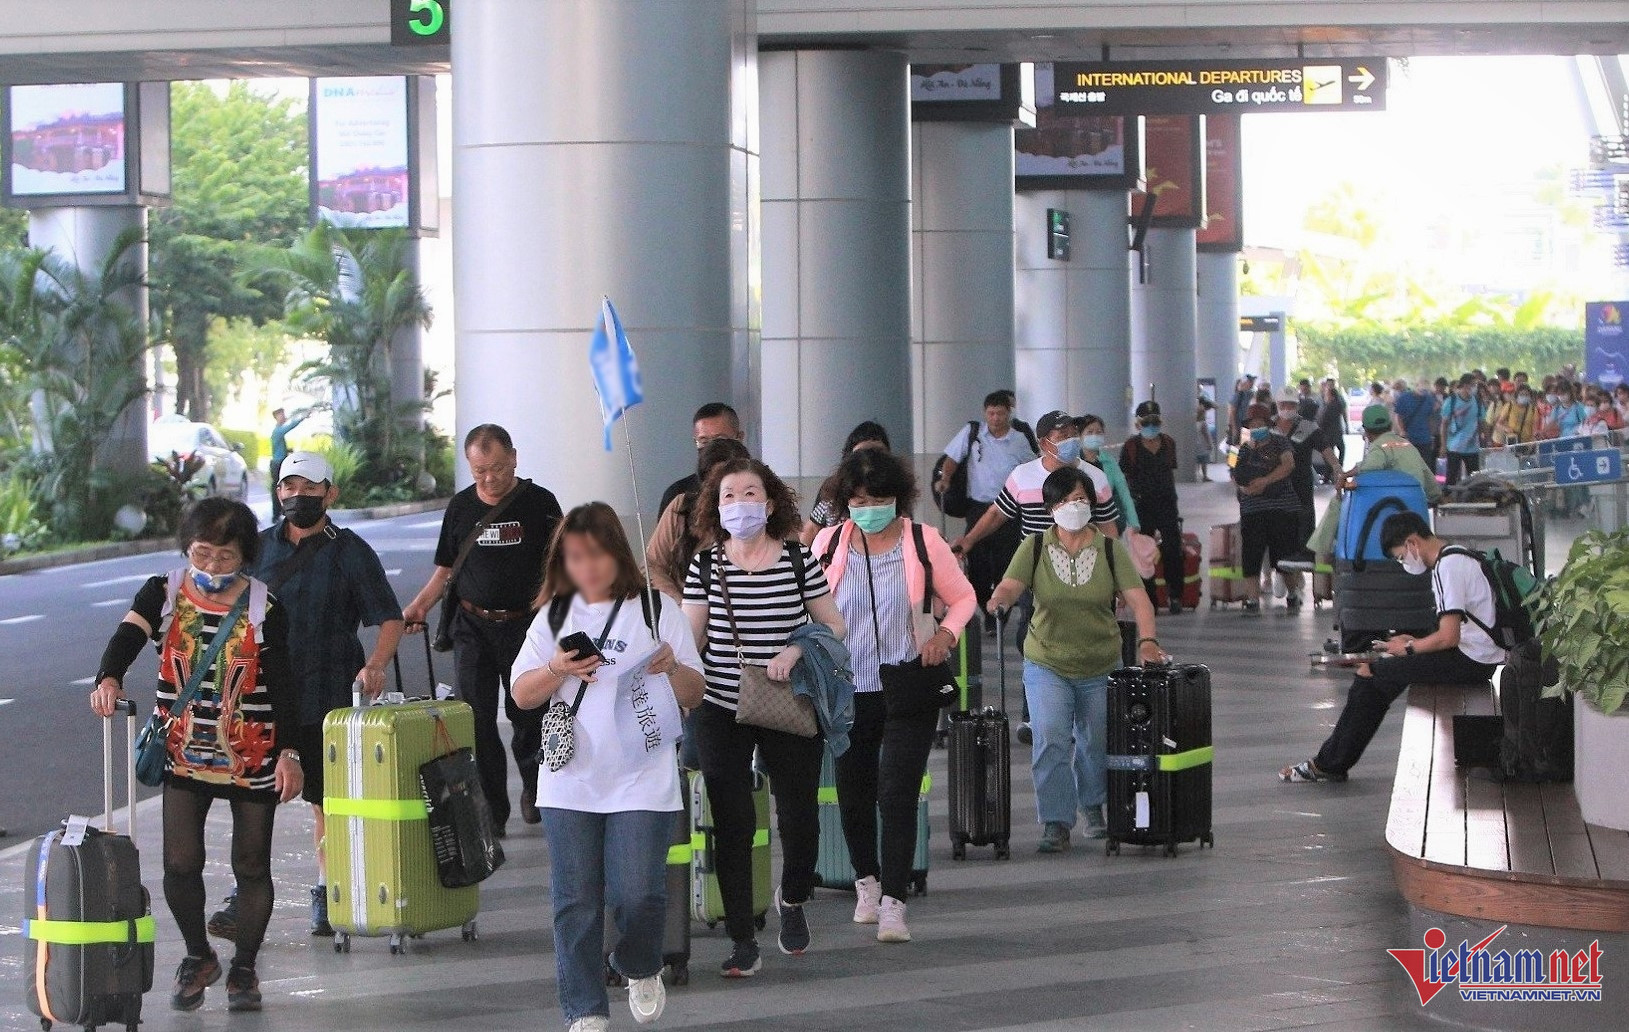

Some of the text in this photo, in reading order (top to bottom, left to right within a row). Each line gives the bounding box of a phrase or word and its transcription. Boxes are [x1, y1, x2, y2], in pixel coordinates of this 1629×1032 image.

[408, 0, 443, 35] 5
[1077, 70, 1302, 87] INTERNATIONAL DEPARTURES
[1211, 86, 1303, 105] Ga đi quốc tế
